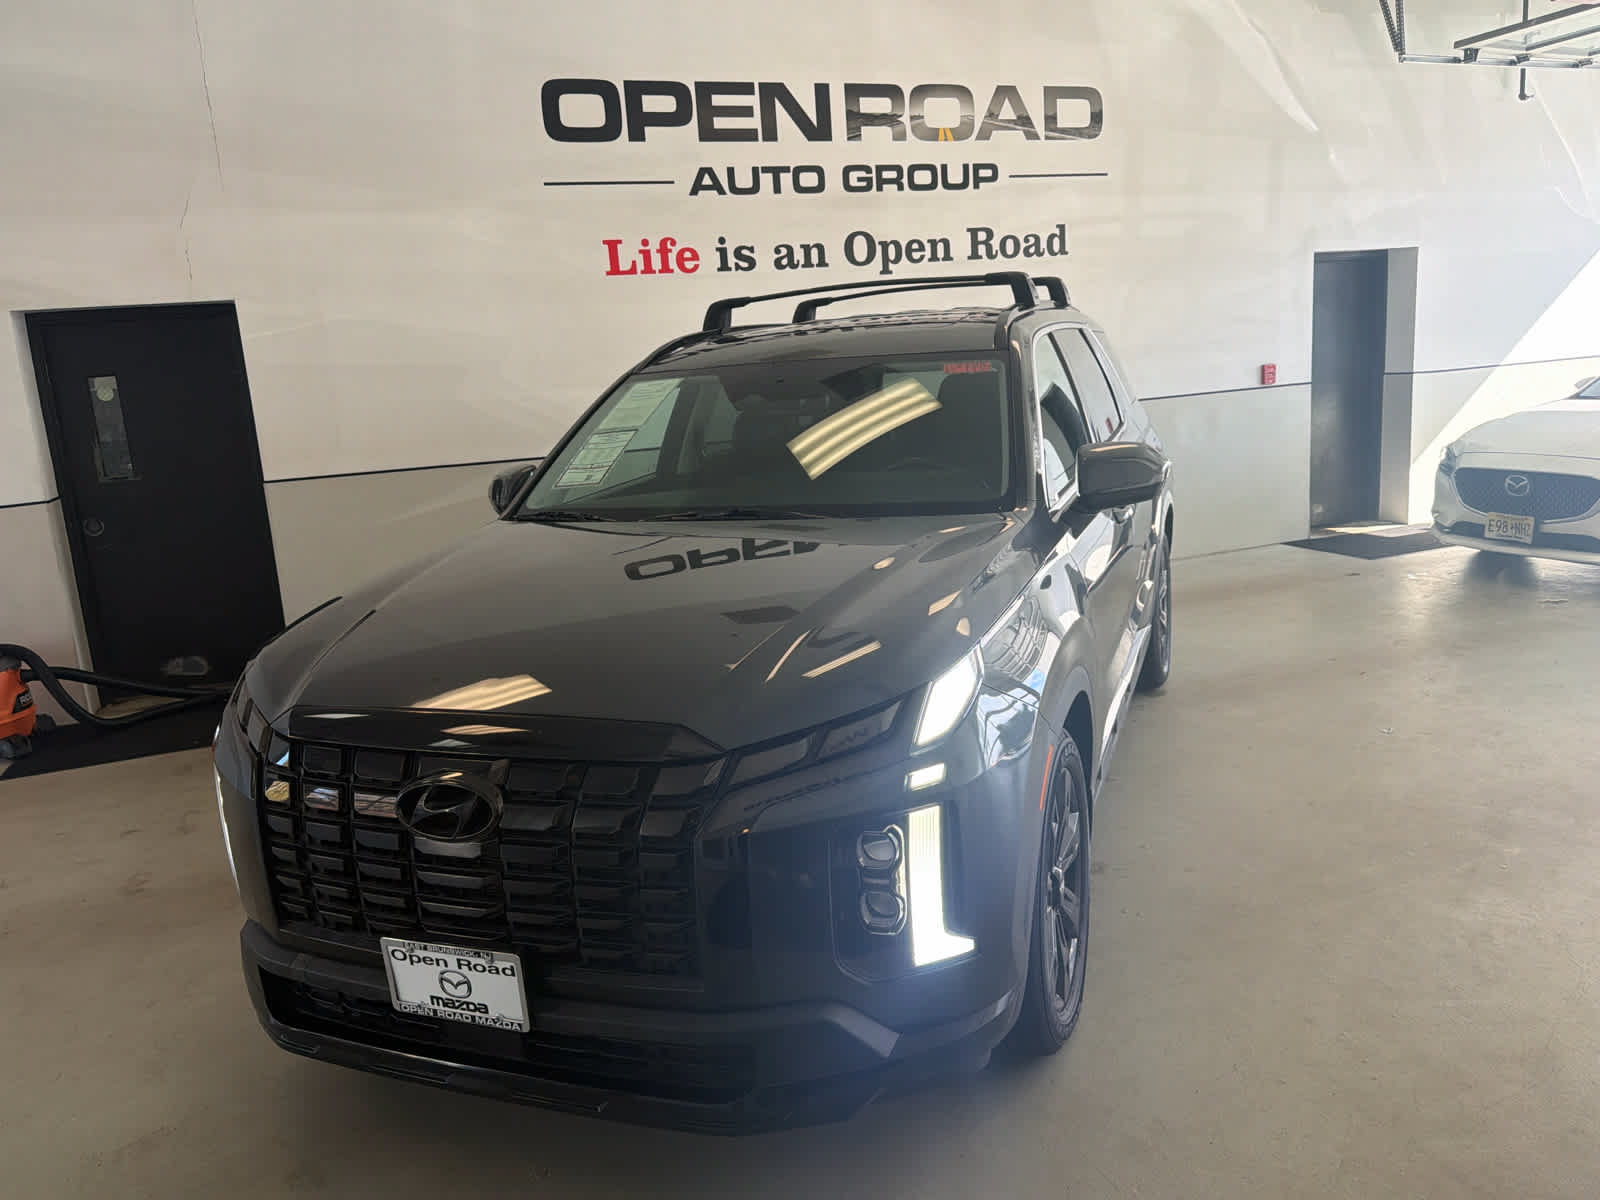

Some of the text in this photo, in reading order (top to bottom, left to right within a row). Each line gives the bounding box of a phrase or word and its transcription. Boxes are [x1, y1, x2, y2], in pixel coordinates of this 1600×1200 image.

[540, 78, 1104, 143] OPEN ROAD
[689, 162, 999, 196] AUTO GROUP
[602, 223, 1069, 276] Life is an Open Road
[391, 948, 516, 977] Open Road
[400, 1003, 521, 1031] OPEN ROAD MAZDA
[429, 994, 489, 1015] mazda
